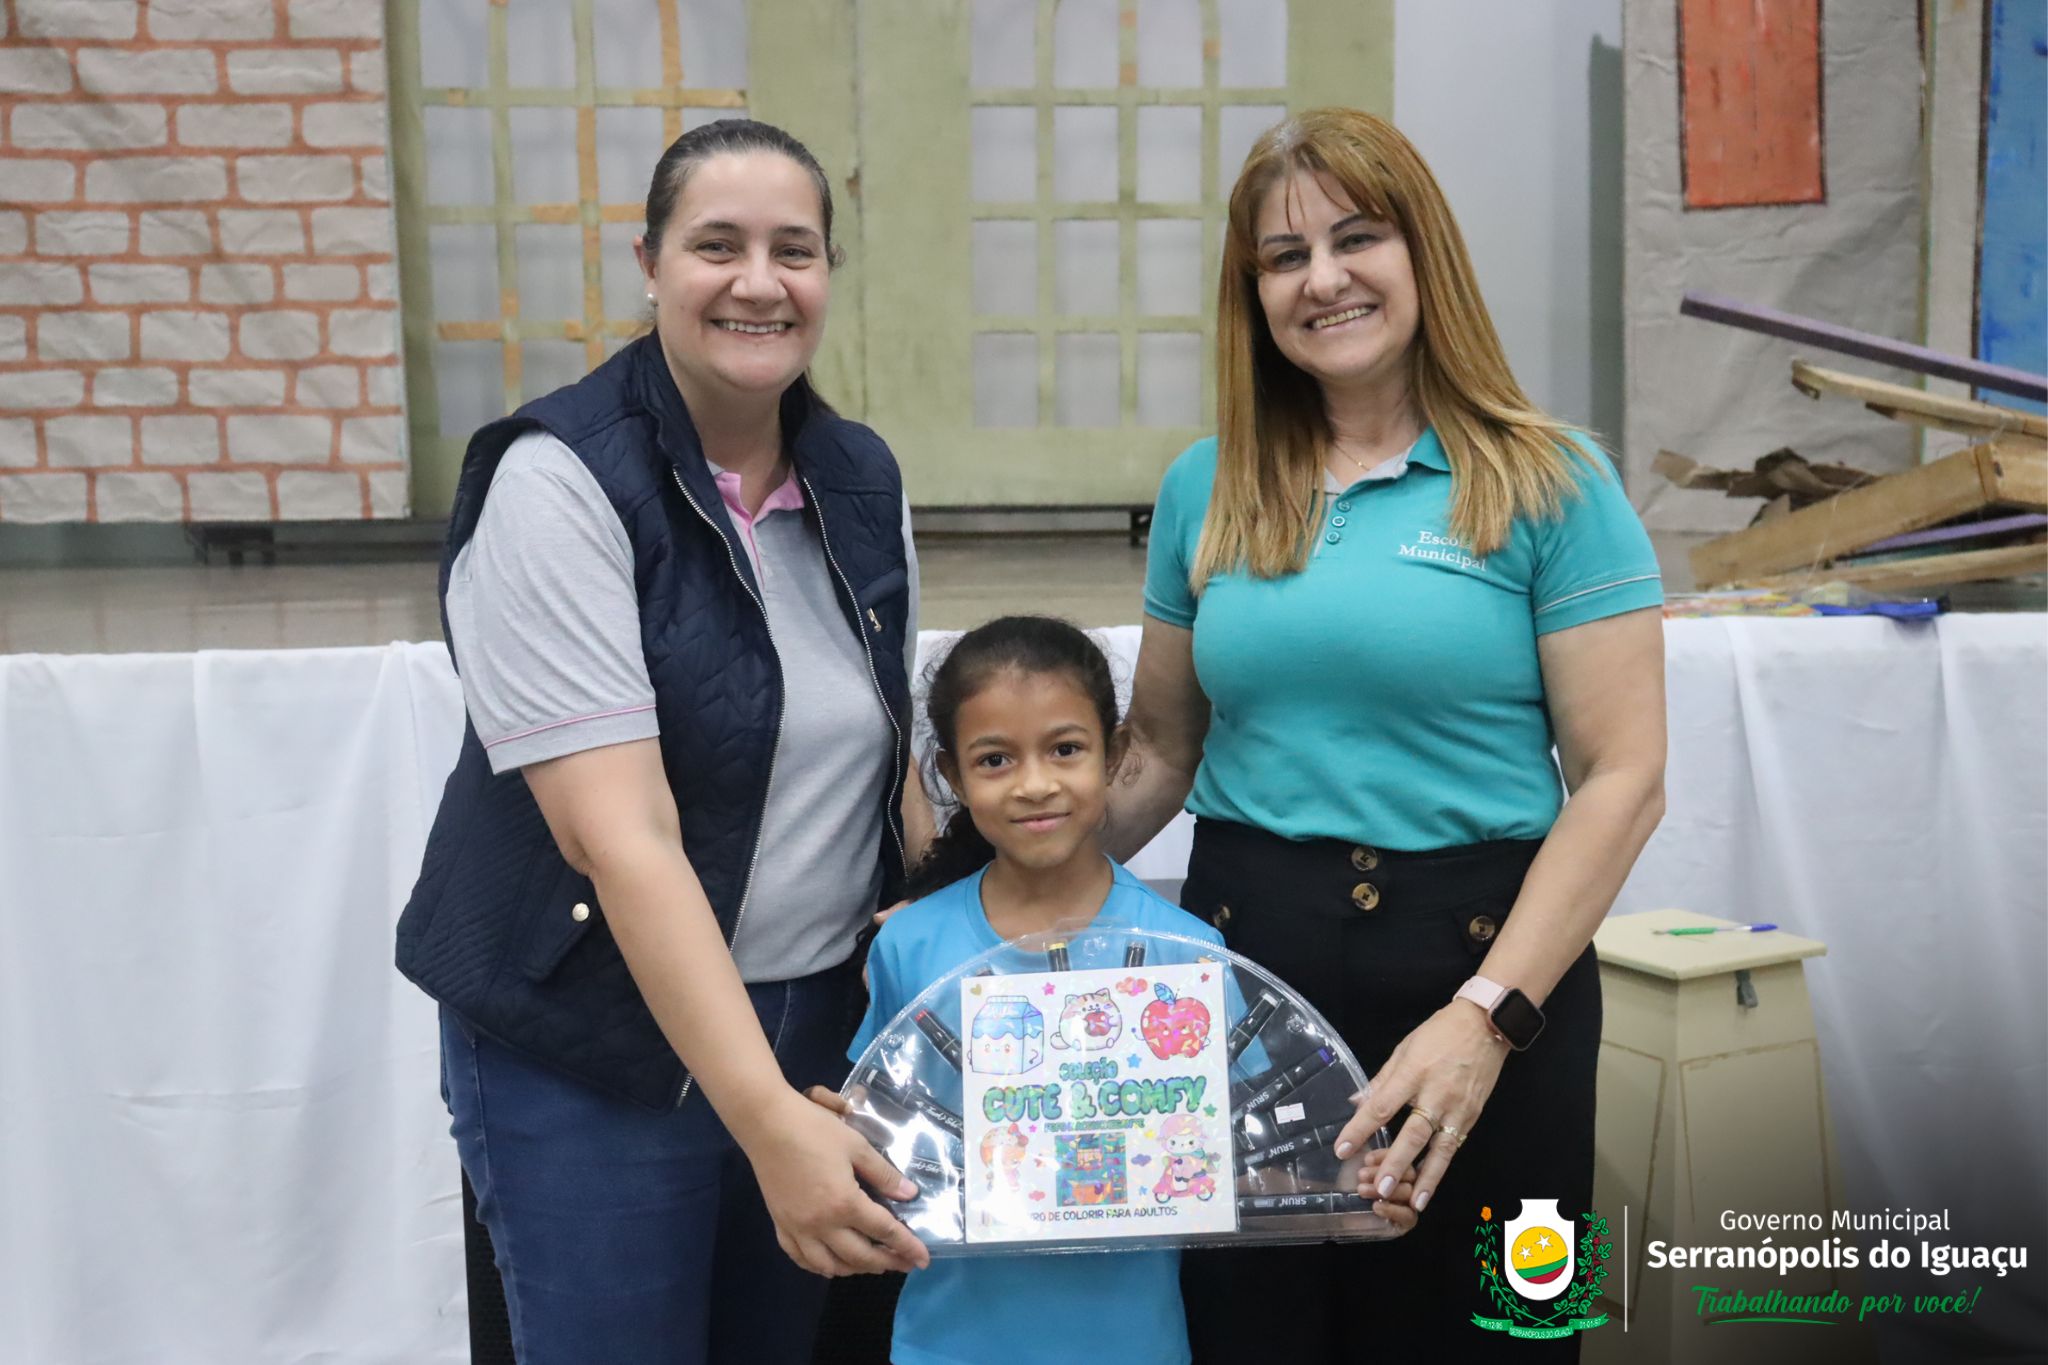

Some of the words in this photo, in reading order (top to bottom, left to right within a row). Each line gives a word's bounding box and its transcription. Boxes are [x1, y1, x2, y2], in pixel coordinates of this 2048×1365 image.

[1398, 544, 1486, 572] Municipal
[982, 1083, 1062, 1123] CUTE
[1071, 1081, 1097, 1119] &
[1098, 1075, 1207, 1117] COMFY
[1280, 1196, 1307, 1206] SRUN
[1049, 1212, 1061, 1221] DE
[1063, 1209, 1104, 1221] COLORIR
[1106, 1208, 1131, 1219] PARA
[1134, 1206, 1178, 1218] ADULTOS
